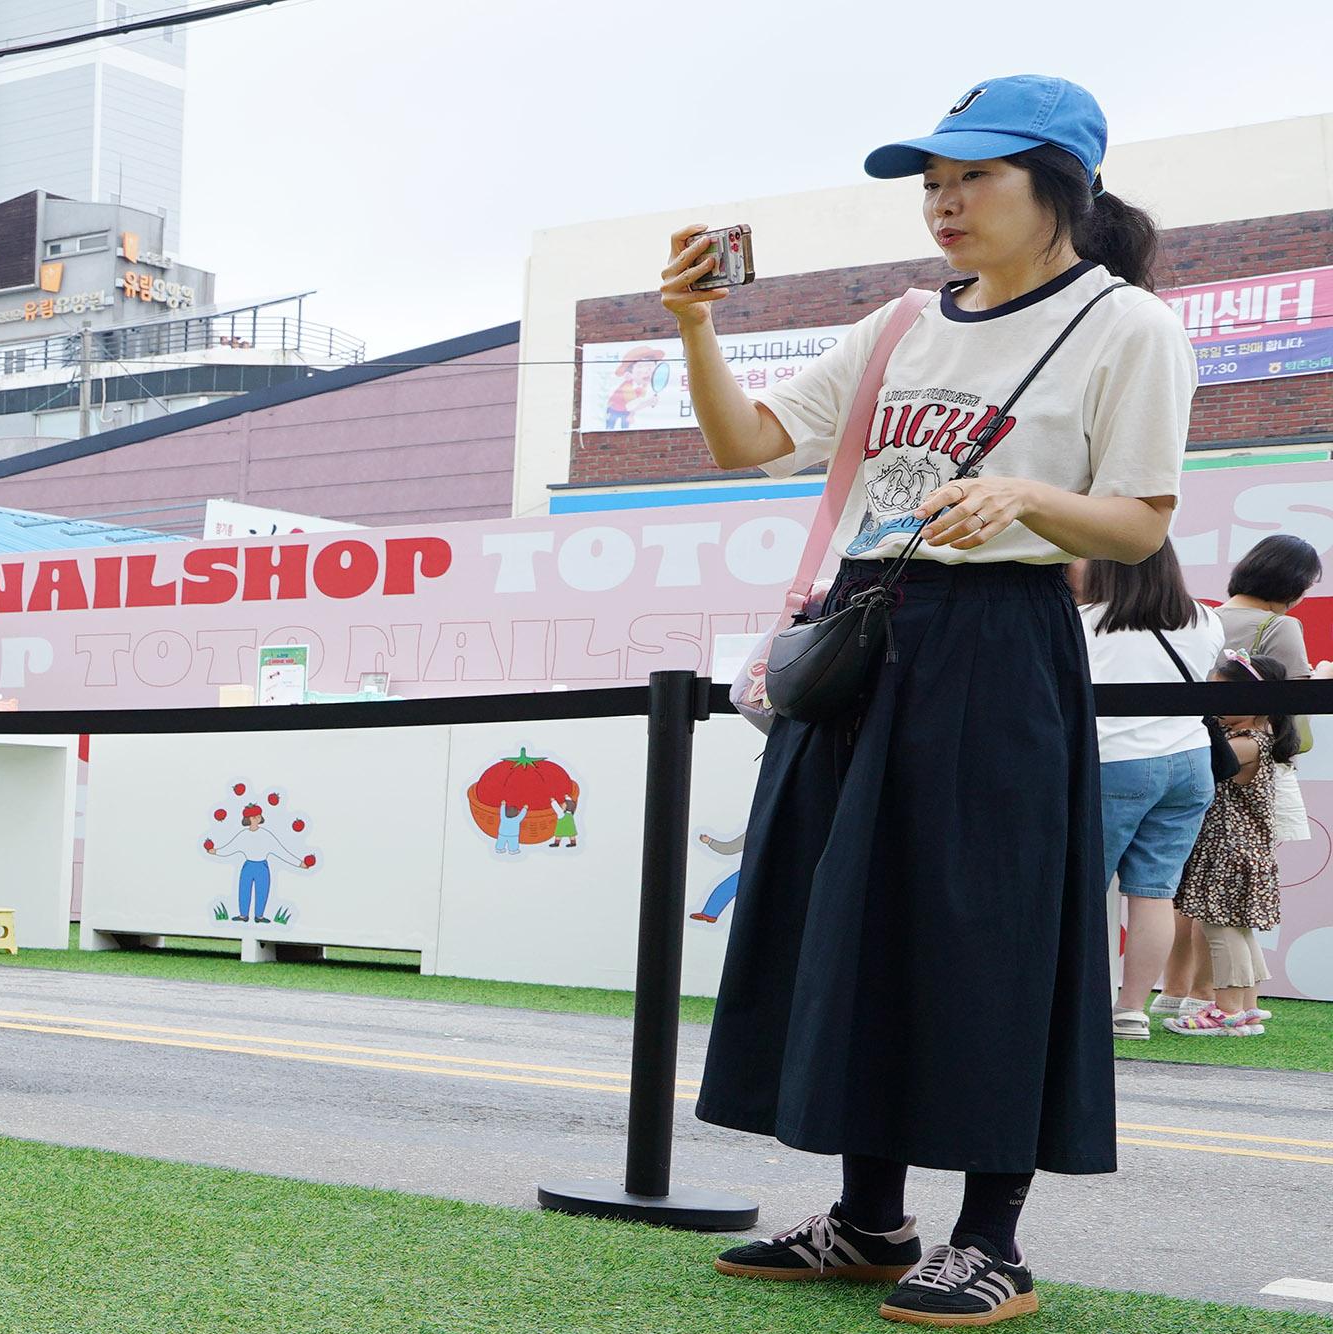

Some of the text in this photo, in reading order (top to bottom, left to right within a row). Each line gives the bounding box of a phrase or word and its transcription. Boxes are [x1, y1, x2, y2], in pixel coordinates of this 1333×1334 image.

[124, 271, 194, 308] 유림요양원
[25, 290, 105, 321] 유림요양원
[1224, 346, 1236, 356] 도
[1239, 343, 1263, 355] 판매
[1266, 337, 1305, 351] 합니다.
[1199, 363, 1237, 376] 17:30
